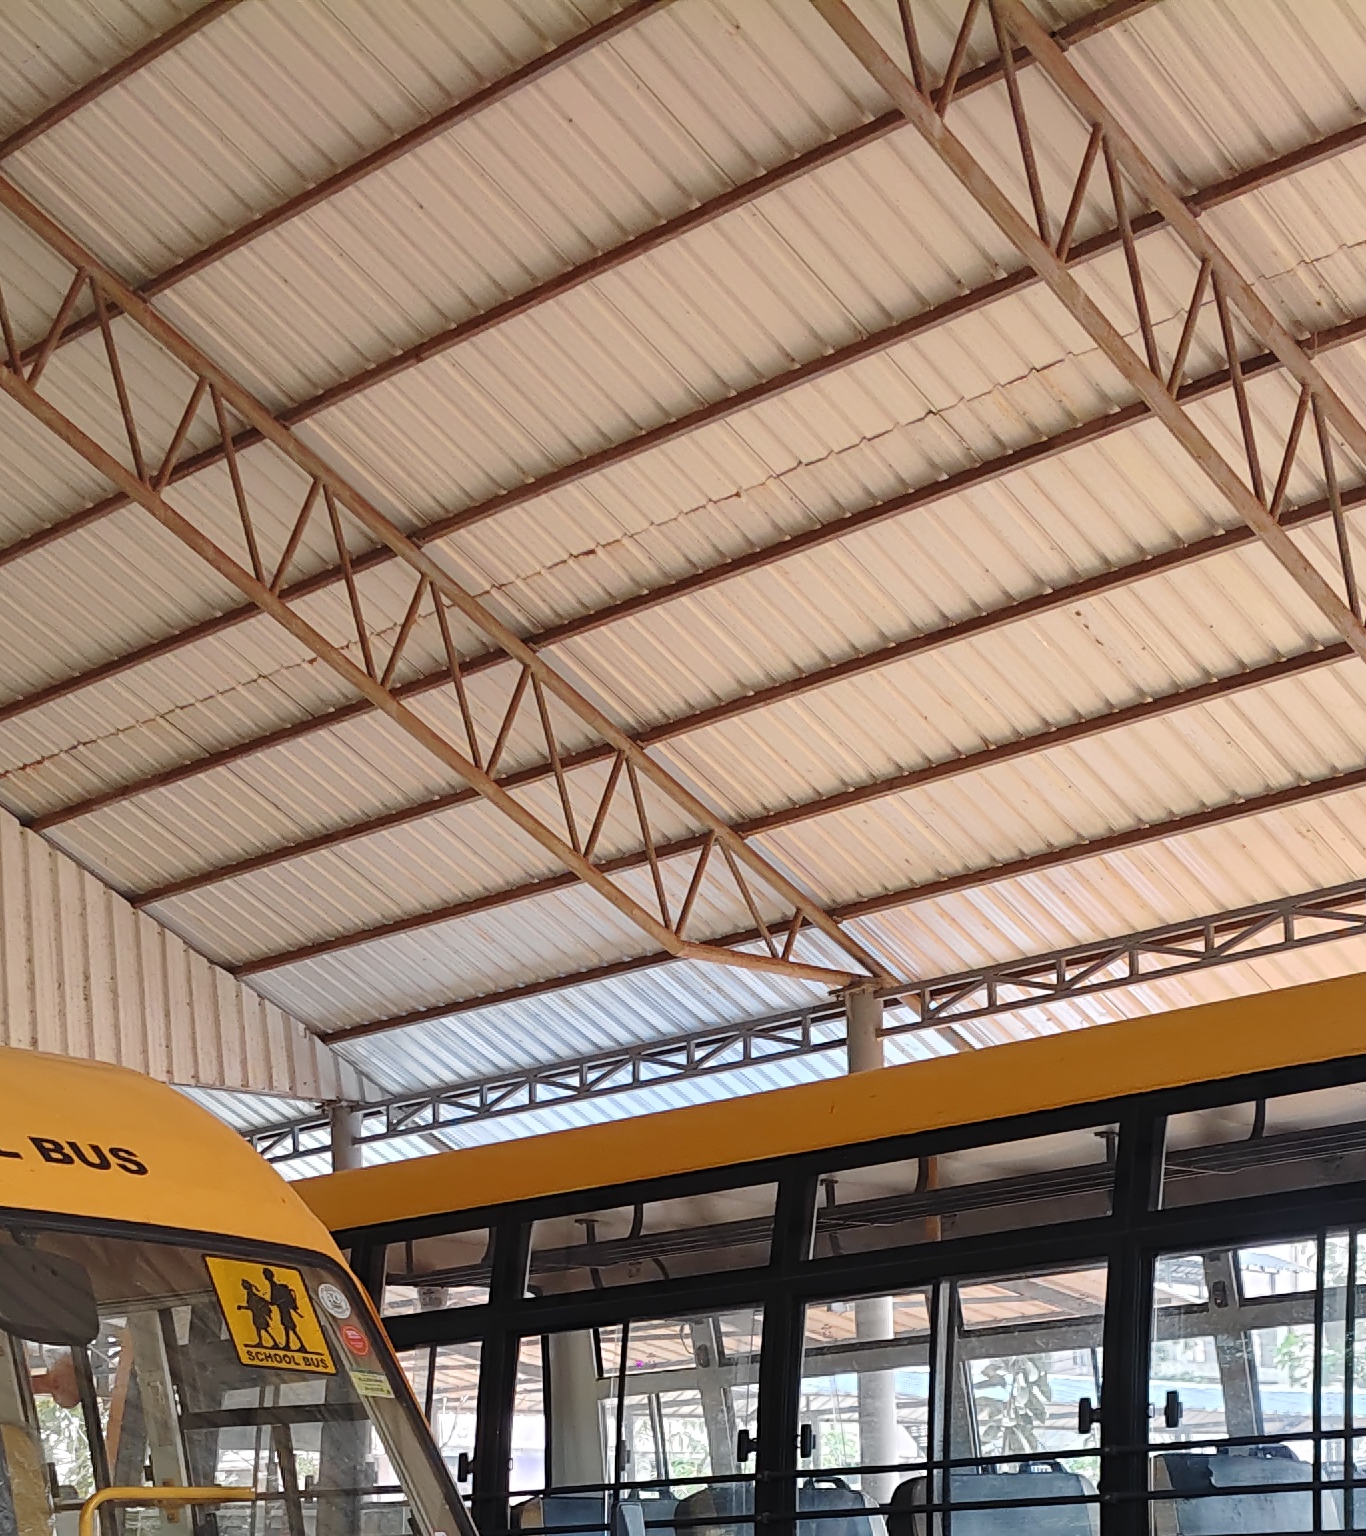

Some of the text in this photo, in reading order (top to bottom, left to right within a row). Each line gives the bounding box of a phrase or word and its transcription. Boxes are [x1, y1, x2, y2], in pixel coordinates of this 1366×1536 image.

[28, 1135, 149, 1176] BUS
[246, 1350, 329, 1370] SCHOOL BUS
